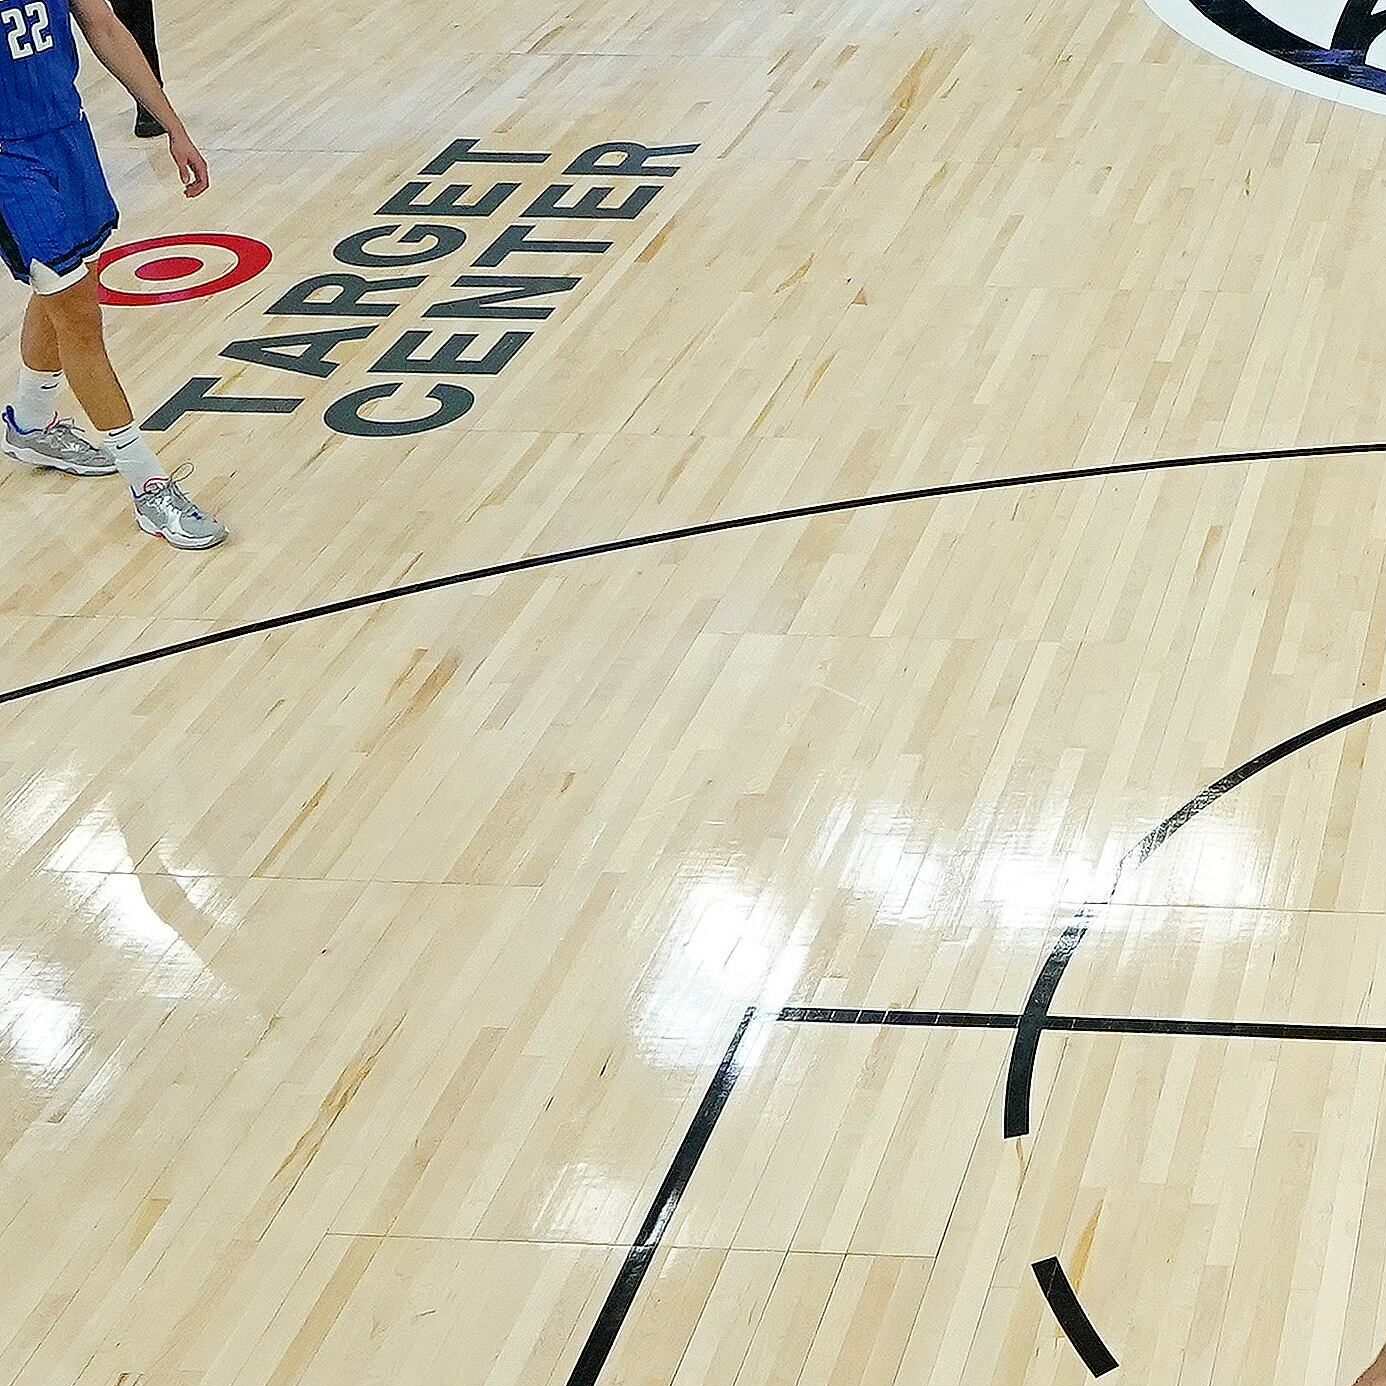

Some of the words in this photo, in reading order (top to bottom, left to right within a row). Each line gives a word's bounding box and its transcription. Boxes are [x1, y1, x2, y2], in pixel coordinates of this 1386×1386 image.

[0, 1, 54, 60] 22
[140, 138, 552, 432] TARGET
[324, 142, 701, 437] CENTER
